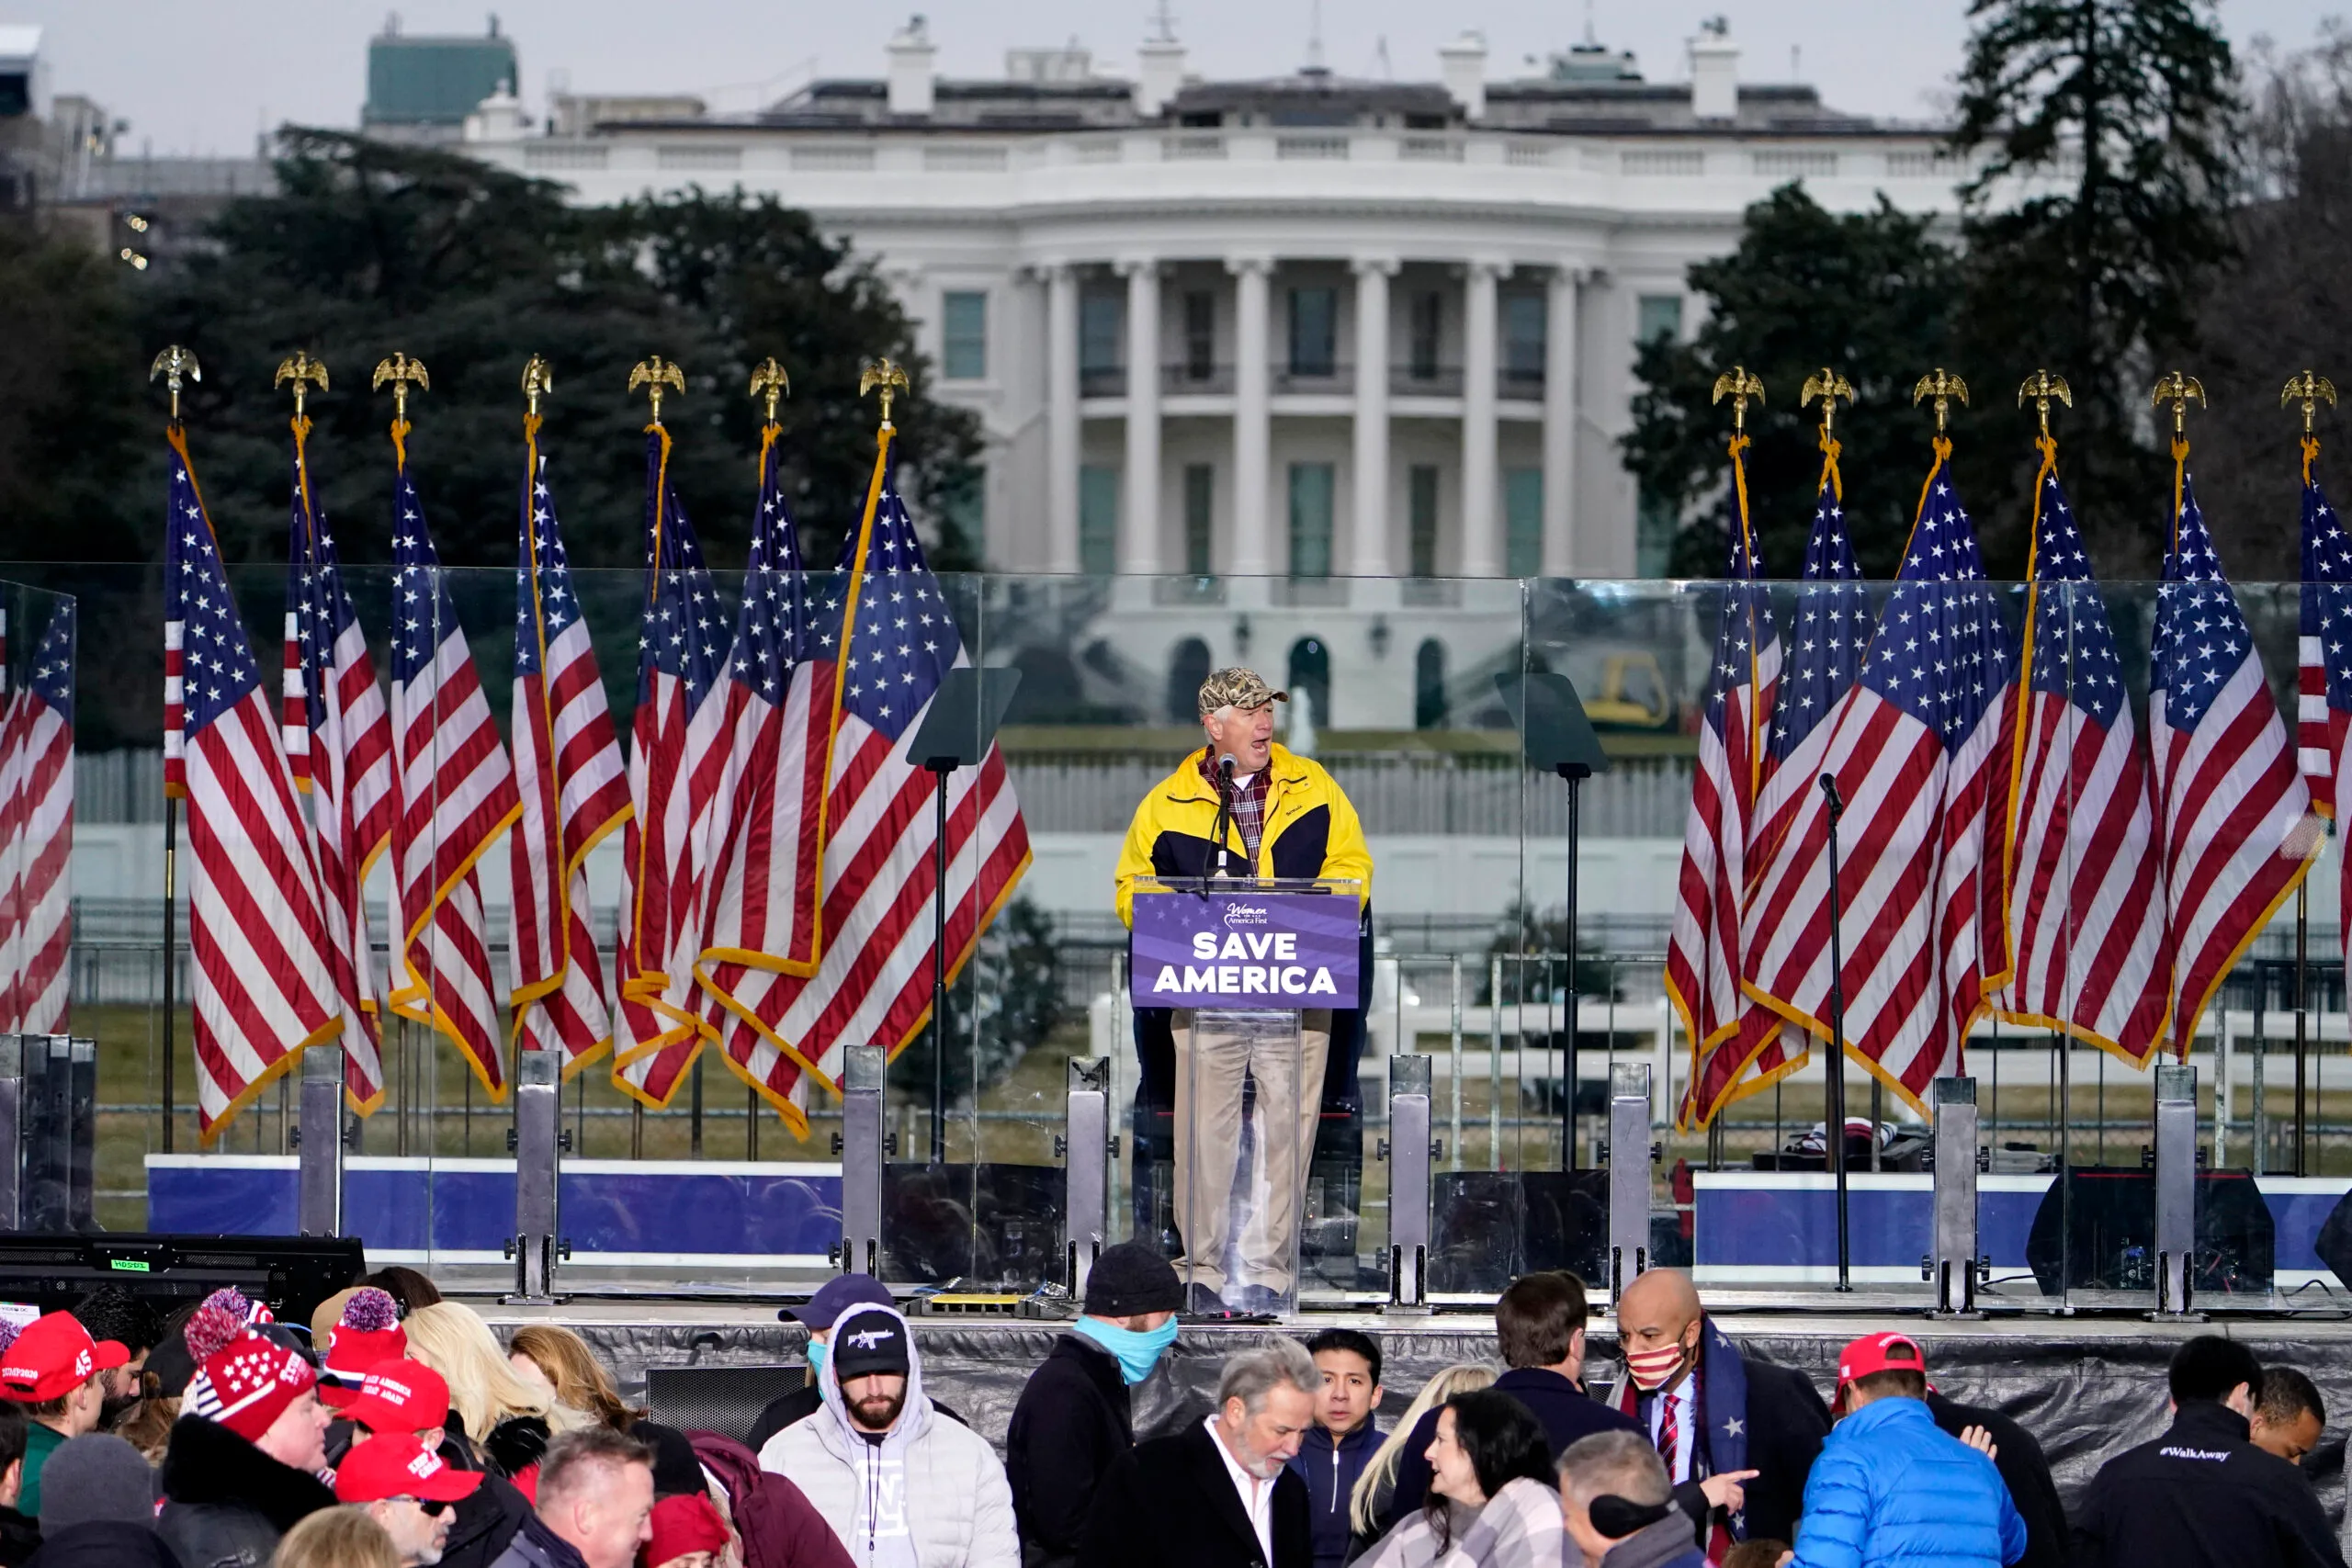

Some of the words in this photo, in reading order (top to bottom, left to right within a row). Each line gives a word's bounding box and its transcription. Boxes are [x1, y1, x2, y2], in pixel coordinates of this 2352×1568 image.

[1227, 903, 1268, 914] Women
[1193, 931, 1297, 960] SAVE
[1152, 965, 1338, 995] AMERICA
[75, 1348, 92, 1376] 45
[379, 1377, 412, 1398] AMERICA
[379, 1390, 404, 1406] AGAIN
[2159, 1447, 2231, 1462] #WalkAway
